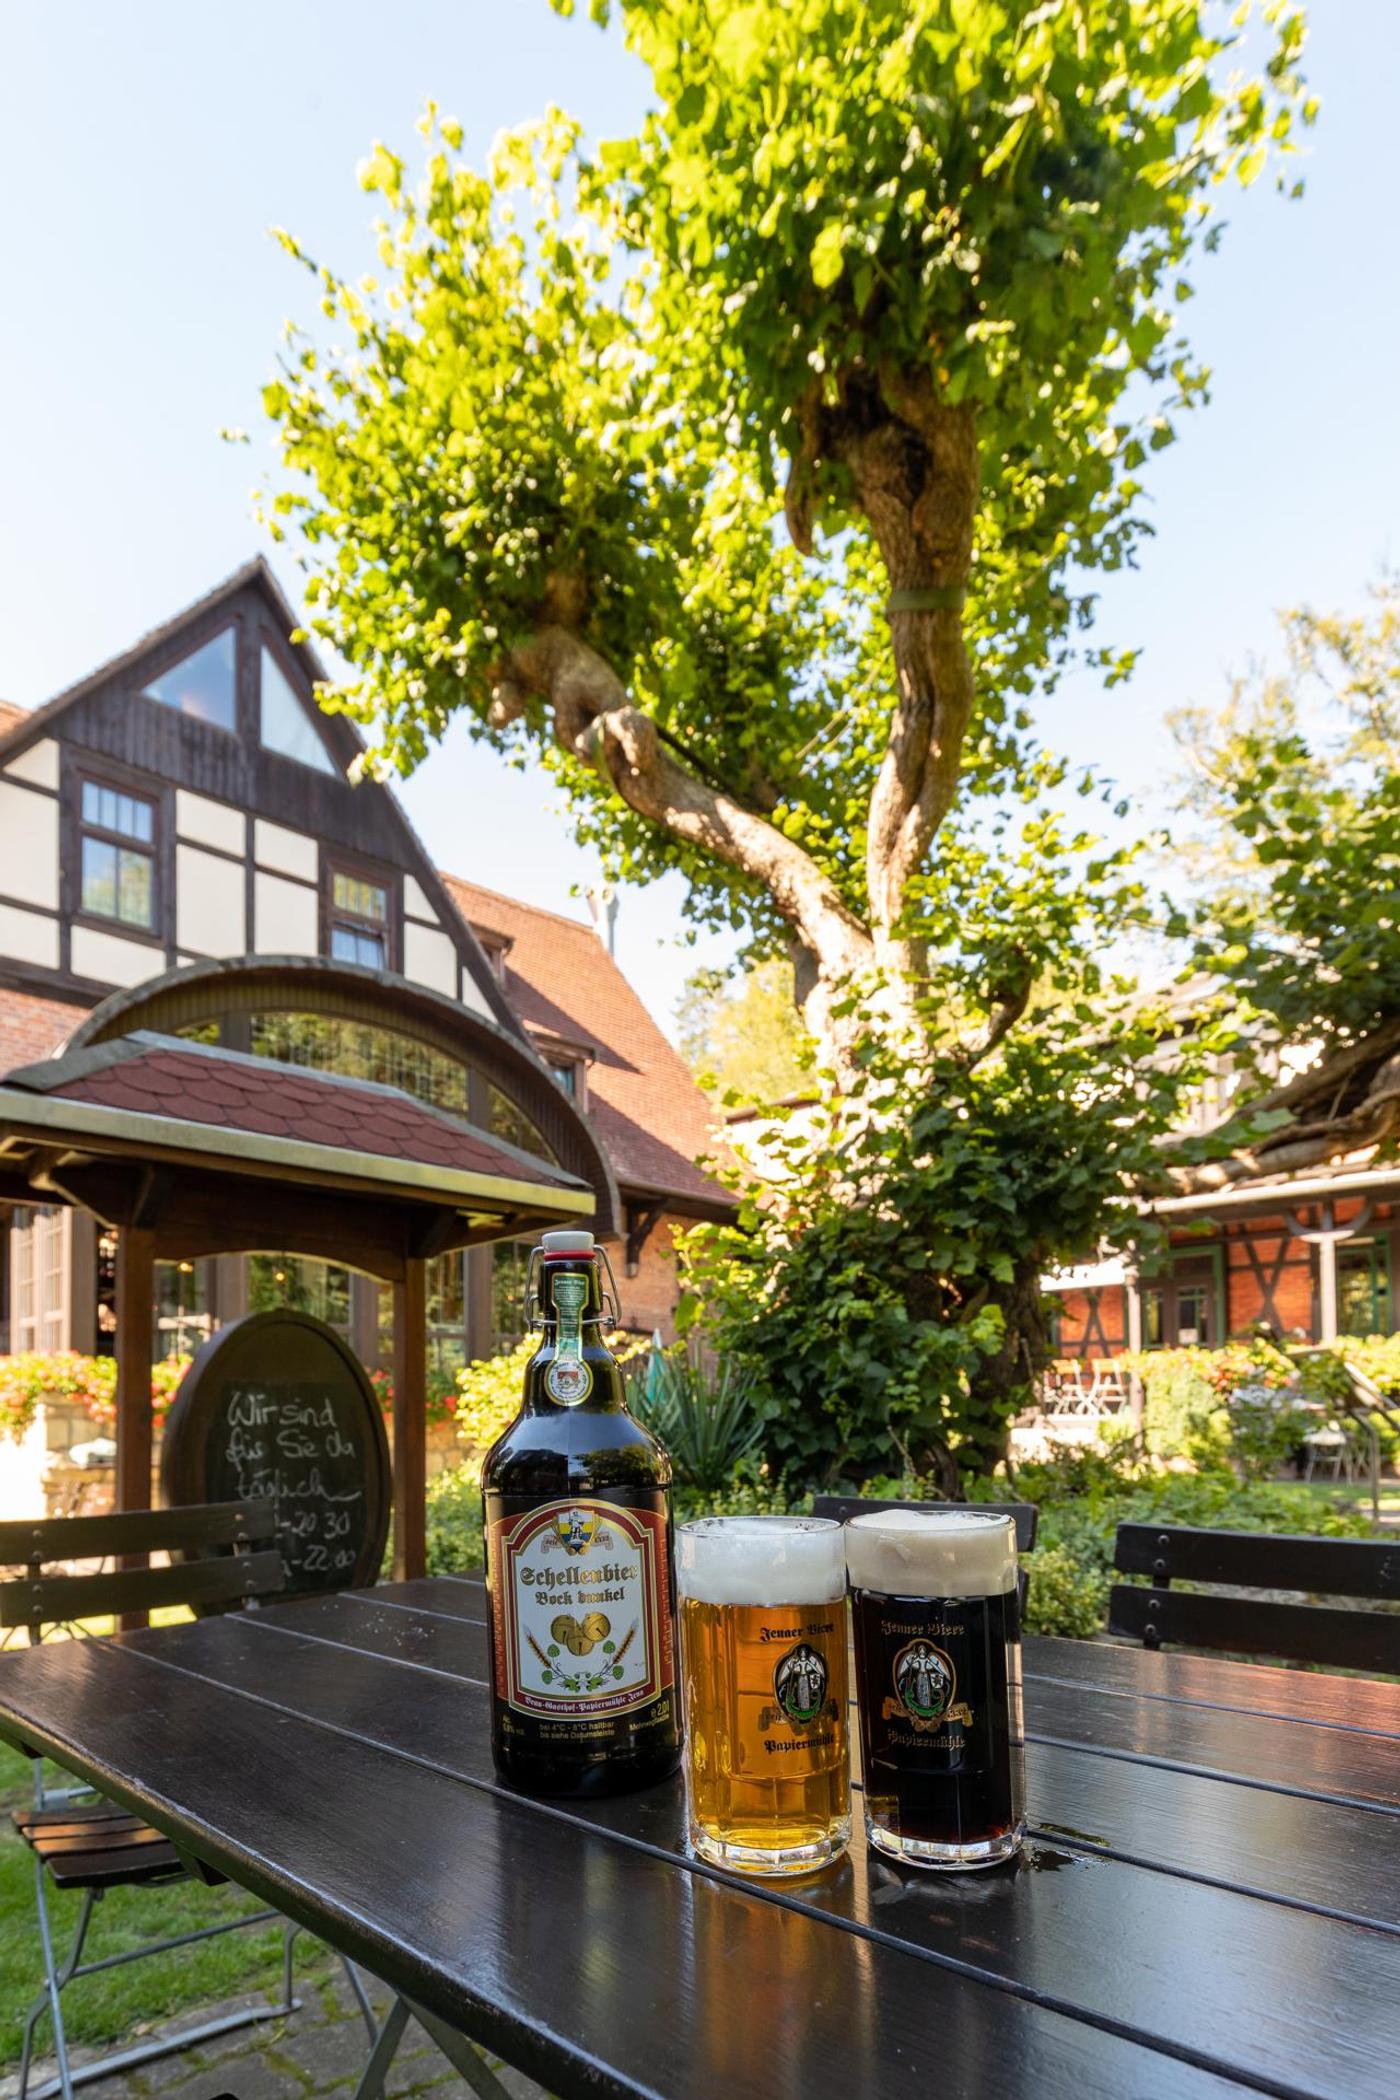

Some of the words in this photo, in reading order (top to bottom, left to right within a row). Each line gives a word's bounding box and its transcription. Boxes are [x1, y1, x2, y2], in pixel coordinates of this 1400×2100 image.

[227, 1391, 277, 1426] Wir
[279, 1396, 337, 1428] sind
[225, 1426, 265, 1472] für
[276, 1428, 320, 1459] Sie
[325, 1431, 356, 1458] da
[236, 1467, 363, 1502] täglich
[520, 1563, 639, 1591] Schellenbier
[535, 1591, 574, 1606] Bock
[577, 1587, 626, 1605] dunkel
[760, 1627, 803, 1642] Jenaer
[764, 1732, 835, 1755] Papiermühle
